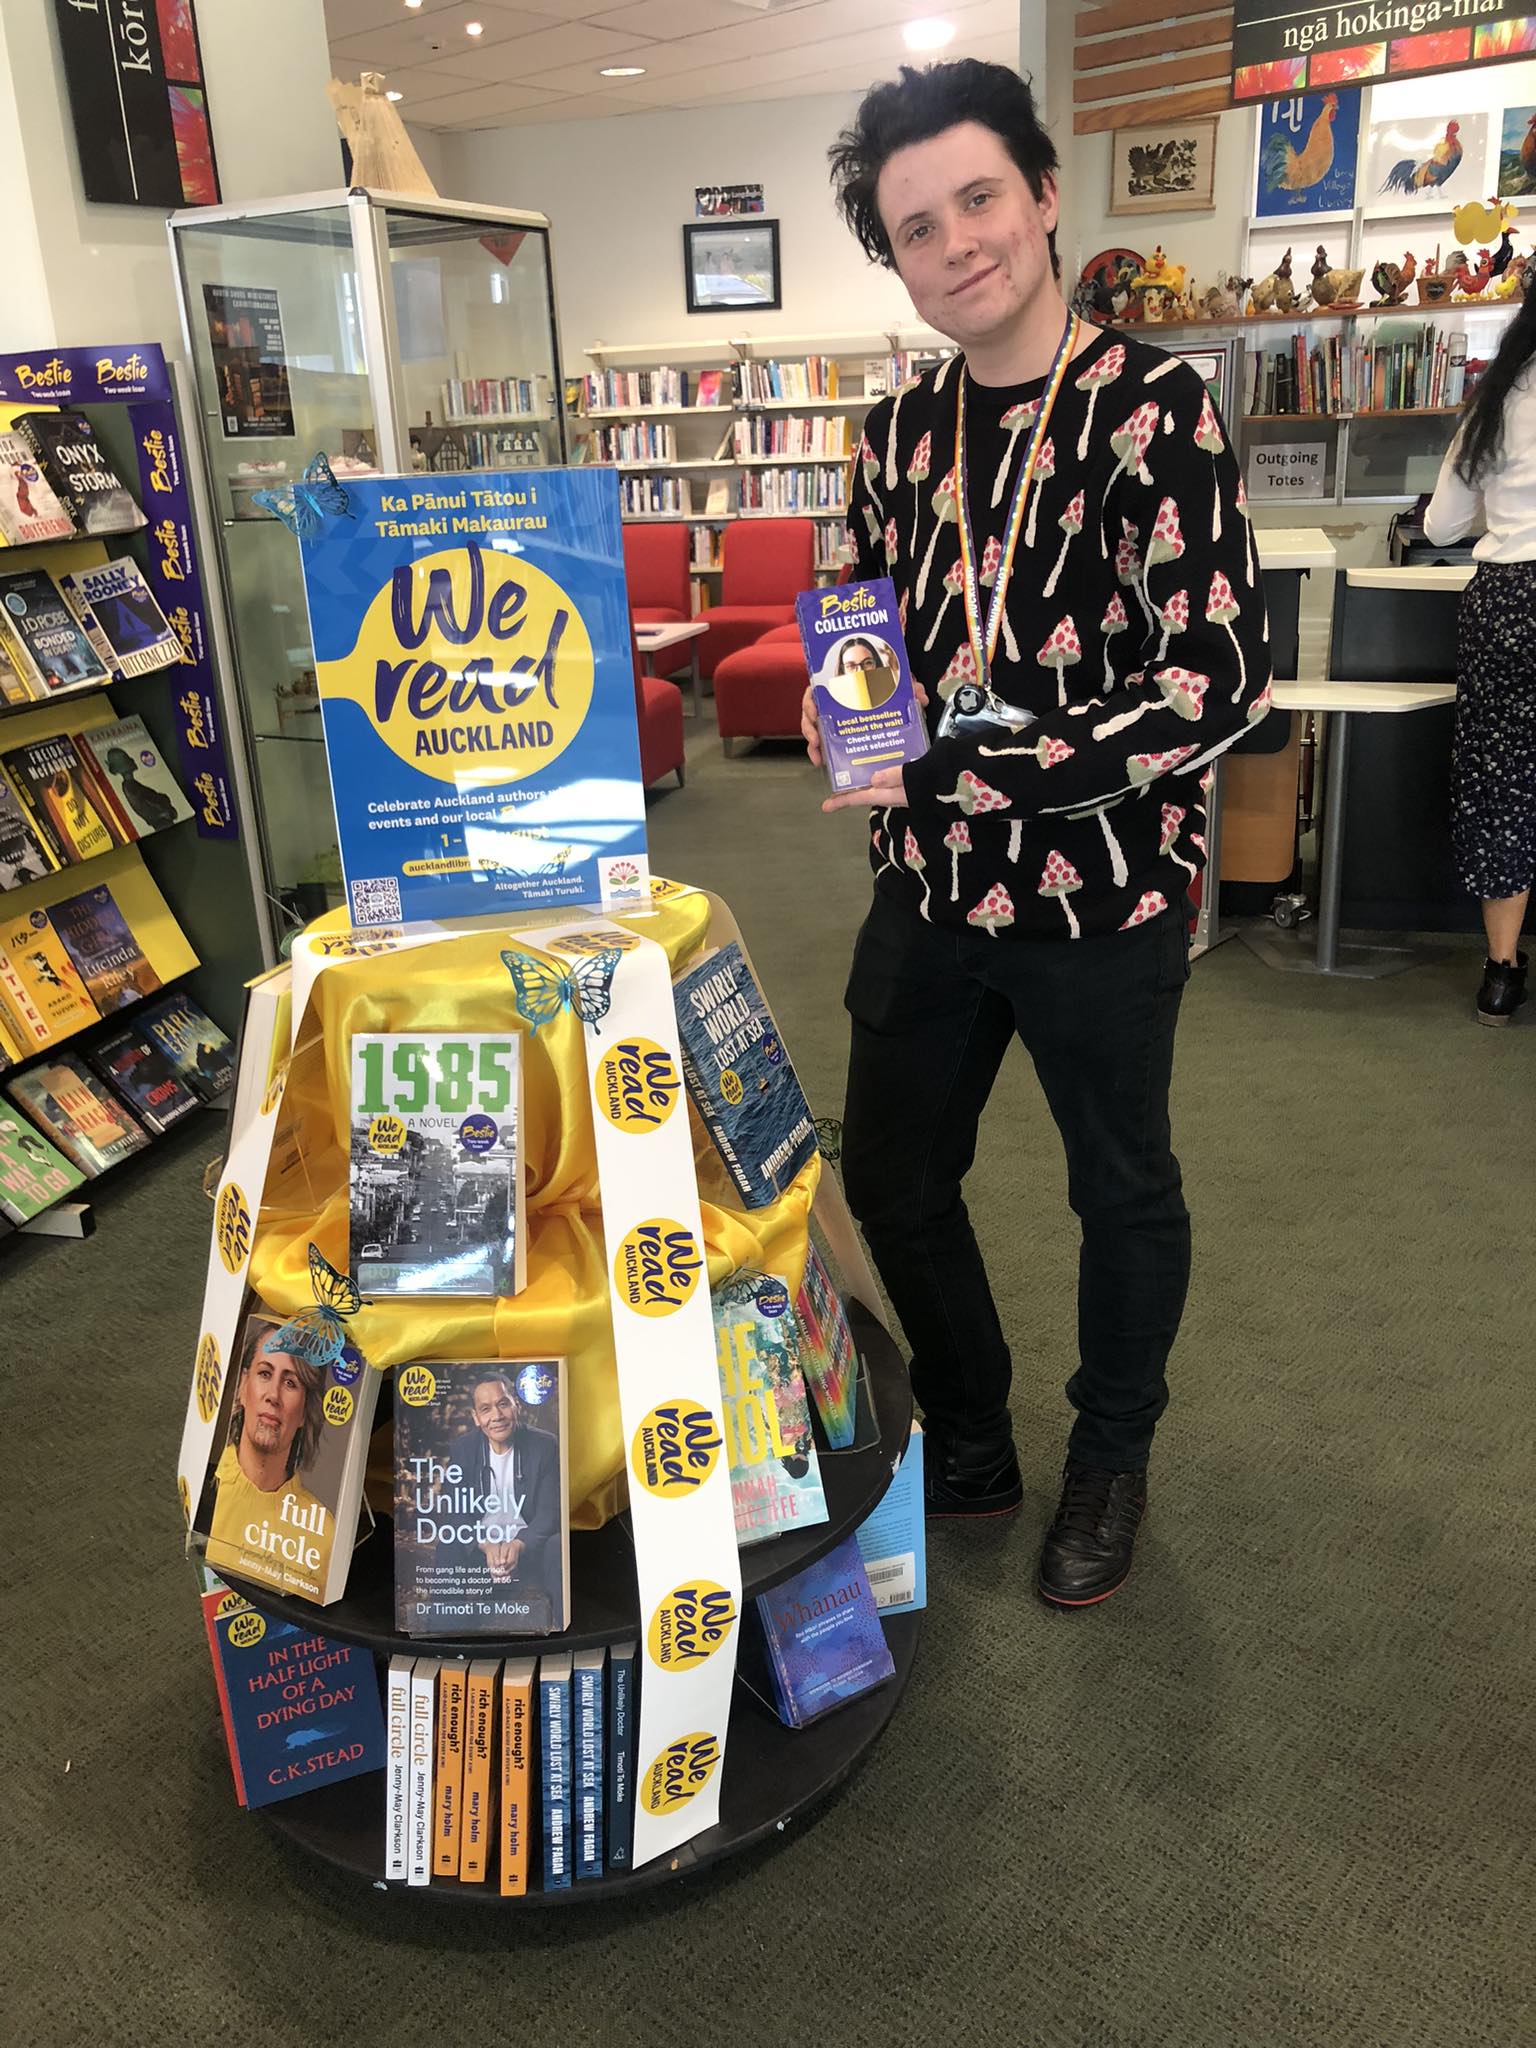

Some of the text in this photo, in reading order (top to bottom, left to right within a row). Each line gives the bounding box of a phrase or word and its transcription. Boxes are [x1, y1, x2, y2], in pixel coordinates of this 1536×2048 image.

[121, 0, 152, 74] kōr
[1283, 17, 1329, 52] ngā
[15, 358, 73, 389] Bestie
[96, 353, 148, 385] Bestie
[56, 444, 105, 465] ONYX
[143, 429, 173, 494] Bestie
[1256, 450, 1319, 466] Outgoing
[69, 471, 122, 493] STORM
[1267, 474, 1304, 486] Totes
[381, 487, 537, 513] Ka Pānui Tātou i
[375, 514, 547, 538] Tāmaki Makaurau
[154, 519, 186, 581] Bestie
[82, 566, 127, 590] SALLY
[83, 574, 139, 601] ROONEY
[965, 566, 979, 619] AUCKLAND
[391, 540, 527, 650] We
[820, 586, 877, 618] Bestie
[985, 566, 1008, 648] LOVE RAINBOW
[168, 606, 198, 667] Bestie
[814, 609, 889, 635] COLLECTION
[33, 630, 76, 650] BONDED
[119, 638, 184, 677] INTERMEZZO
[375, 609, 568, 723] read
[180, 690, 209, 749] Bestie
[837, 709, 902, 727] Local bestsellers
[838, 718, 904, 737] without the wait!
[415, 720, 554, 757] AUCKLAND
[845, 737, 905, 754] latest selection
[847, 730, 900, 745] Check out our
[27, 753, 78, 780] McFADDEN
[28, 744, 64, 766] FREIDA
[194, 771, 225, 828] Bestie
[368, 799, 431, 814] Celebrate
[434, 793, 494, 808] Auckland
[497, 788, 546, 804] authors
[368, 816, 412, 830] events
[415, 813, 439, 827] and
[442, 814, 463, 825] our
[466, 808, 498, 822] local
[77, 824, 108, 854] DISTURB
[441, 834, 449, 848] 1
[494, 875, 584, 891] Altogether Auckland.
[522, 886, 585, 899] Tāmaki Turuki.
[83, 946, 137, 977] Lucinda
[101, 966, 136, 989] Riley
[690, 964, 739, 1020] SWIRLY
[702, 992, 752, 1046] WORLD
[713, 1033, 741, 1072] LOST
[746, 1016, 766, 1044] SEA
[358, 1043, 512, 1113] 1985
[604, 1060, 622, 1121] AUCKLAND
[616, 1044, 662, 1125] read
[643, 1051, 682, 1109] We
[373, 1128, 404, 1144] read
[377, 1116, 398, 1133] We
[408, 1117, 458, 1128] A NOVEL
[462, 1125, 495, 1139] Bestie
[684, 1065, 752, 1194] LOST AT SEA ANDREW FAGAN
[760, 1115, 813, 1182] ANDREW FAGAN
[0, 1162, 38, 1194] WAY
[23, 1167, 71, 1205] TO GO
[624, 1244, 641, 1305] AUCKLAND
[637, 1225, 683, 1307] read
[664, 1230, 704, 1289] We
[402, 1379, 433, 1396] read
[406, 1370, 426, 1385] We
[326, 1400, 352, 1417] read
[331, 1388, 348, 1406] We
[656, 1406, 701, 1490] read
[681, 1409, 724, 1469] We
[410, 1457, 463, 1484] The
[641, 1427, 660, 1487] AUCKLAND
[280, 1493, 327, 1537] full
[416, 1487, 526, 1520] Unlikely
[244, 1519, 322, 1571] circle
[416, 1518, 518, 1544] Doctor
[238, 1555, 282, 1581] Jenny-May
[283, 1570, 320, 1596] Clarkson
[416, 1565, 434, 1573] From
[436, 1567, 454, 1575] gang
[455, 1565, 466, 1573] life
[467, 1565, 481, 1573] and
[416, 1576, 423, 1584] to
[424, 1576, 460, 1586] becoming
[467, 1576, 491, 1584] doctor
[416, 1586, 493, 1596] the incredible story of
[774, 1580, 863, 1634] Whānau
[234, 1615, 255, 1632] We
[416, 1602, 530, 1614] Dr Timoti Te Moke
[234, 1620, 262, 1642] read
[268, 1636, 328, 1666] IN THE
[248, 1648, 352, 1692] HALF LIGHT
[282, 1676, 326, 1700] OF A
[256, 1685, 356, 1729] DYING DAY
[510, 1698, 526, 1770] rich enough?
[616, 1670, 626, 1803] The Unlikely Doctor Timoti Te Moke
[391, 1686, 408, 1854] full circle Jenny-May Clarkson
[667, 1740, 696, 1804] read
[689, 1736, 722, 1784] We
[549, 1687, 564, 1875] SWIRLY WORLD LOST AT SEA ANDREW FAGAN
[506, 1803, 519, 1856] mary holm
